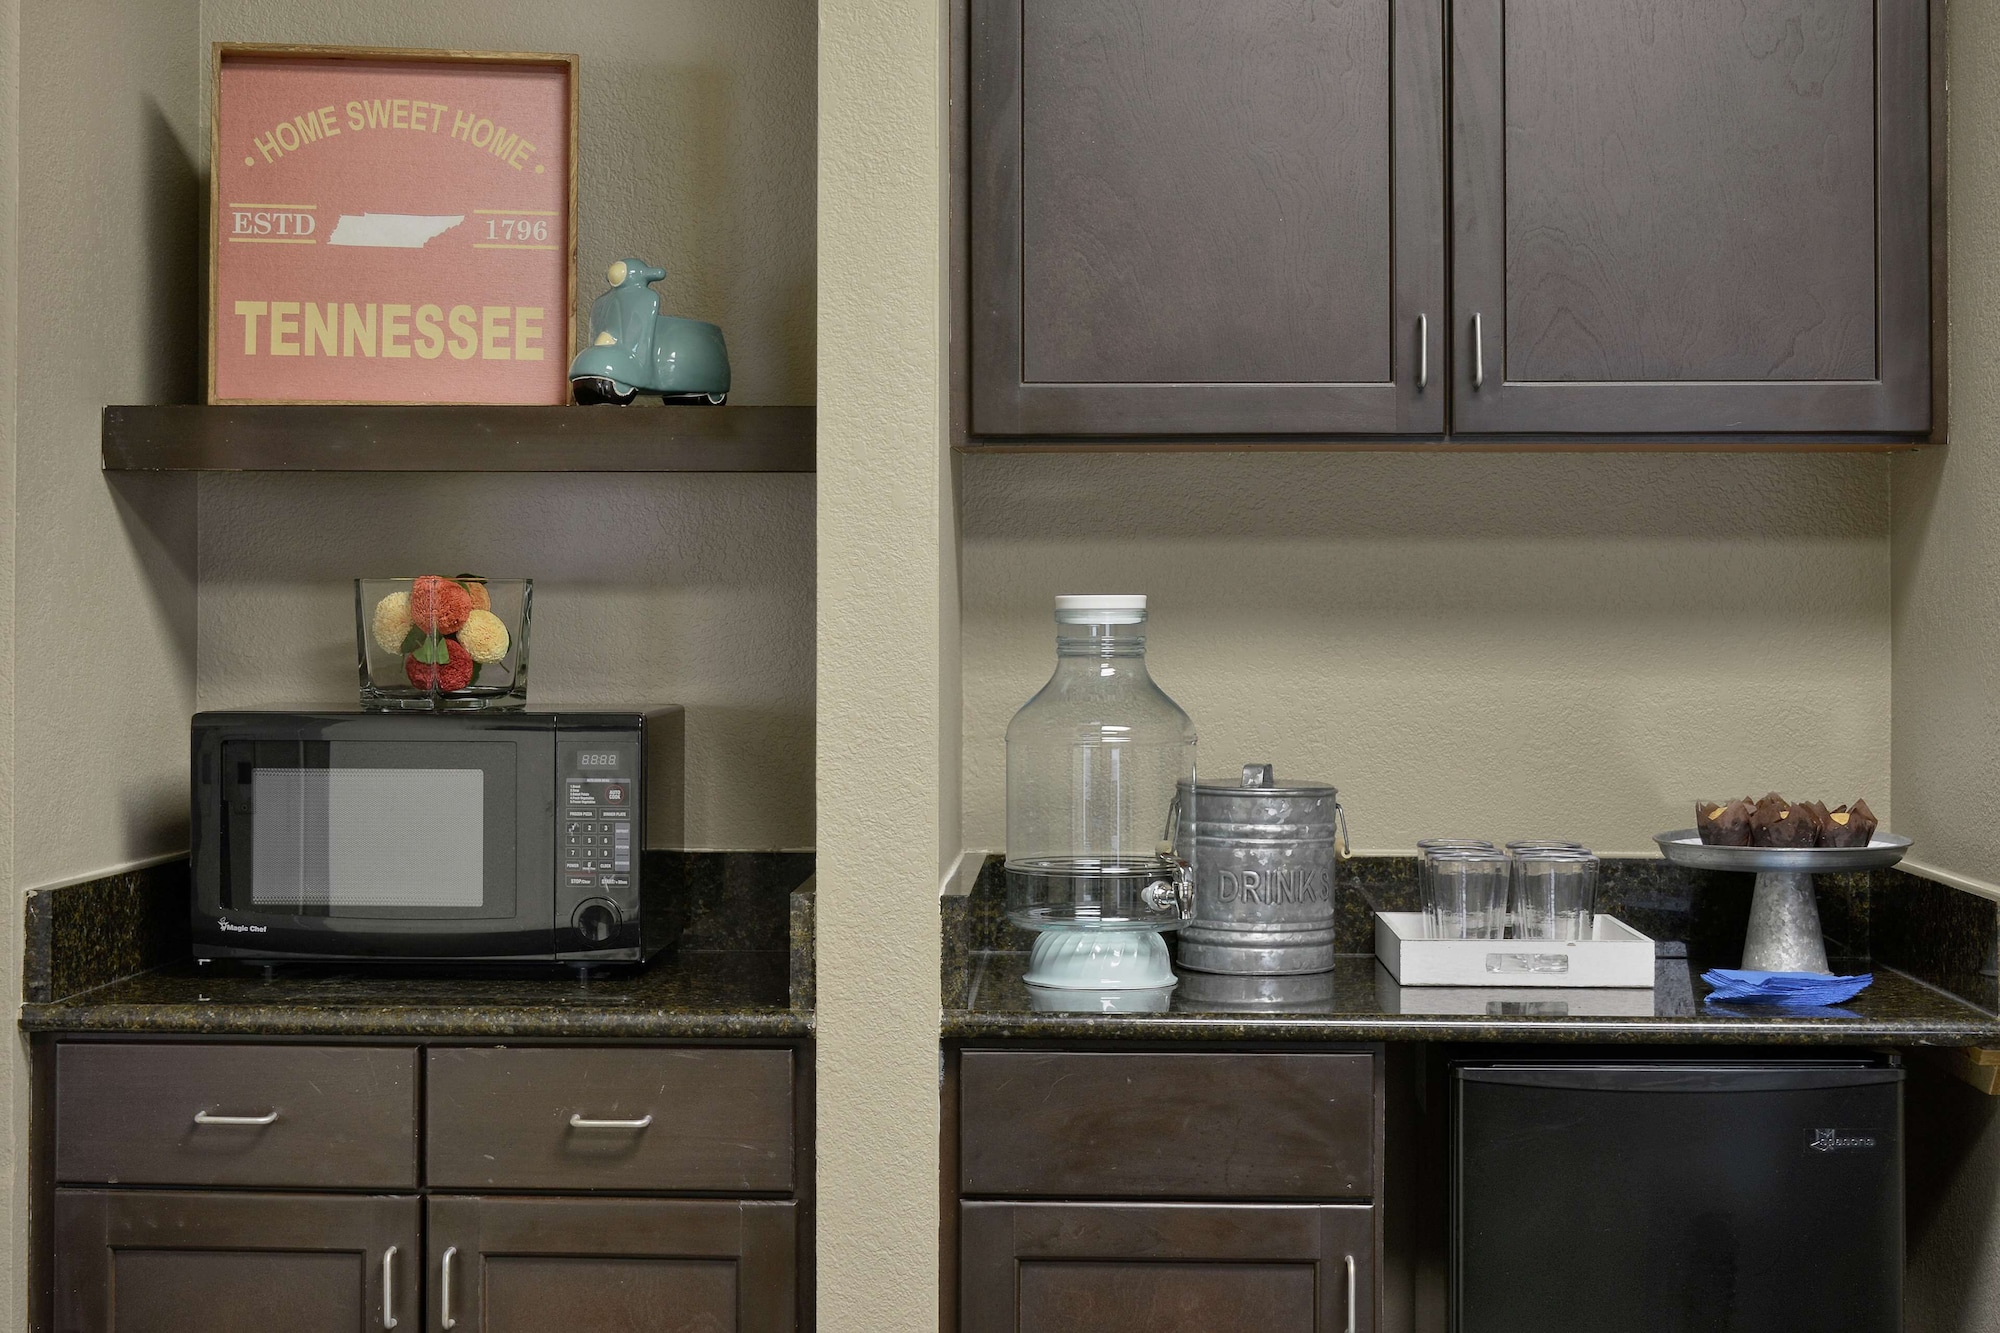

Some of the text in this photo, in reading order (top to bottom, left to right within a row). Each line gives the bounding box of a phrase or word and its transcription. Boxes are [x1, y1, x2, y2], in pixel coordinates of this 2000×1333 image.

[254, 99, 537, 171] HOME SWEET HOME
[232, 212, 316, 236] ESTD
[486, 219, 548, 241] 1796
[235, 300, 545, 361] TENNESSEE
[1217, 867, 1330, 905] DRINKS
[226, 924, 267, 933] Magic Chef
